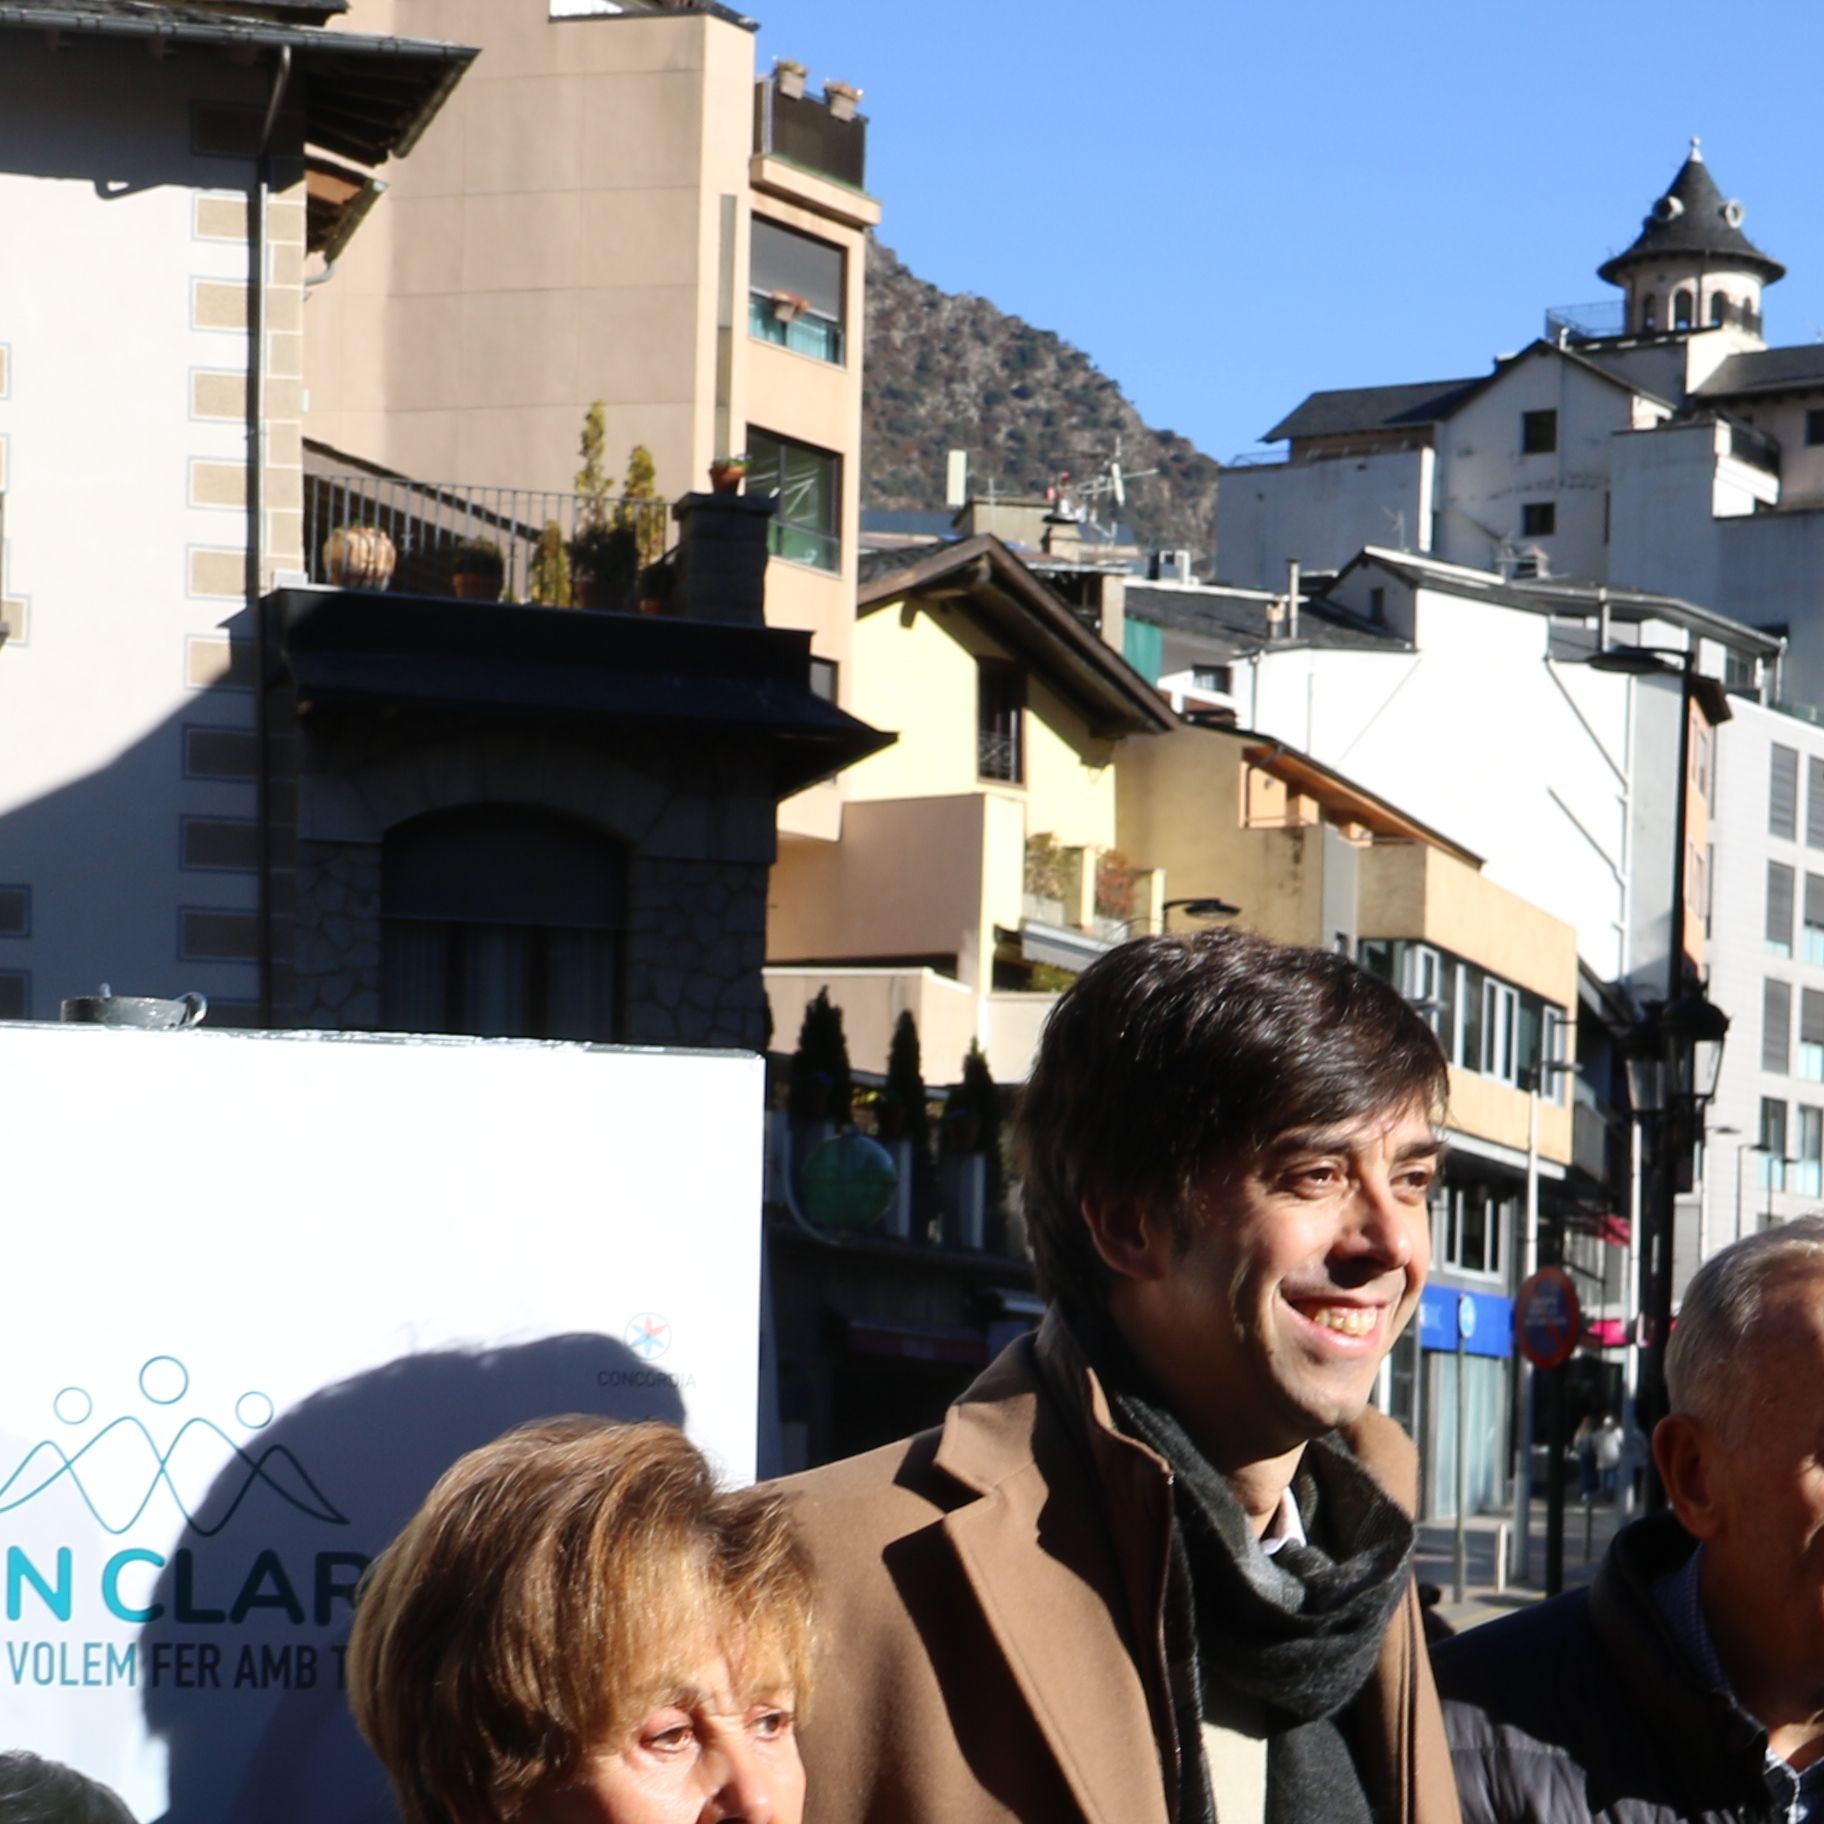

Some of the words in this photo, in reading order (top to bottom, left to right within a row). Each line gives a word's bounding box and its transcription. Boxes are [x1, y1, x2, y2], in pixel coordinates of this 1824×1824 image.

[101, 1547, 372, 1627] CLAR
[7, 1641, 137, 1687] VOLEM
[152, 1643, 222, 1689] FER
[233, 1644, 318, 1690] AMB
